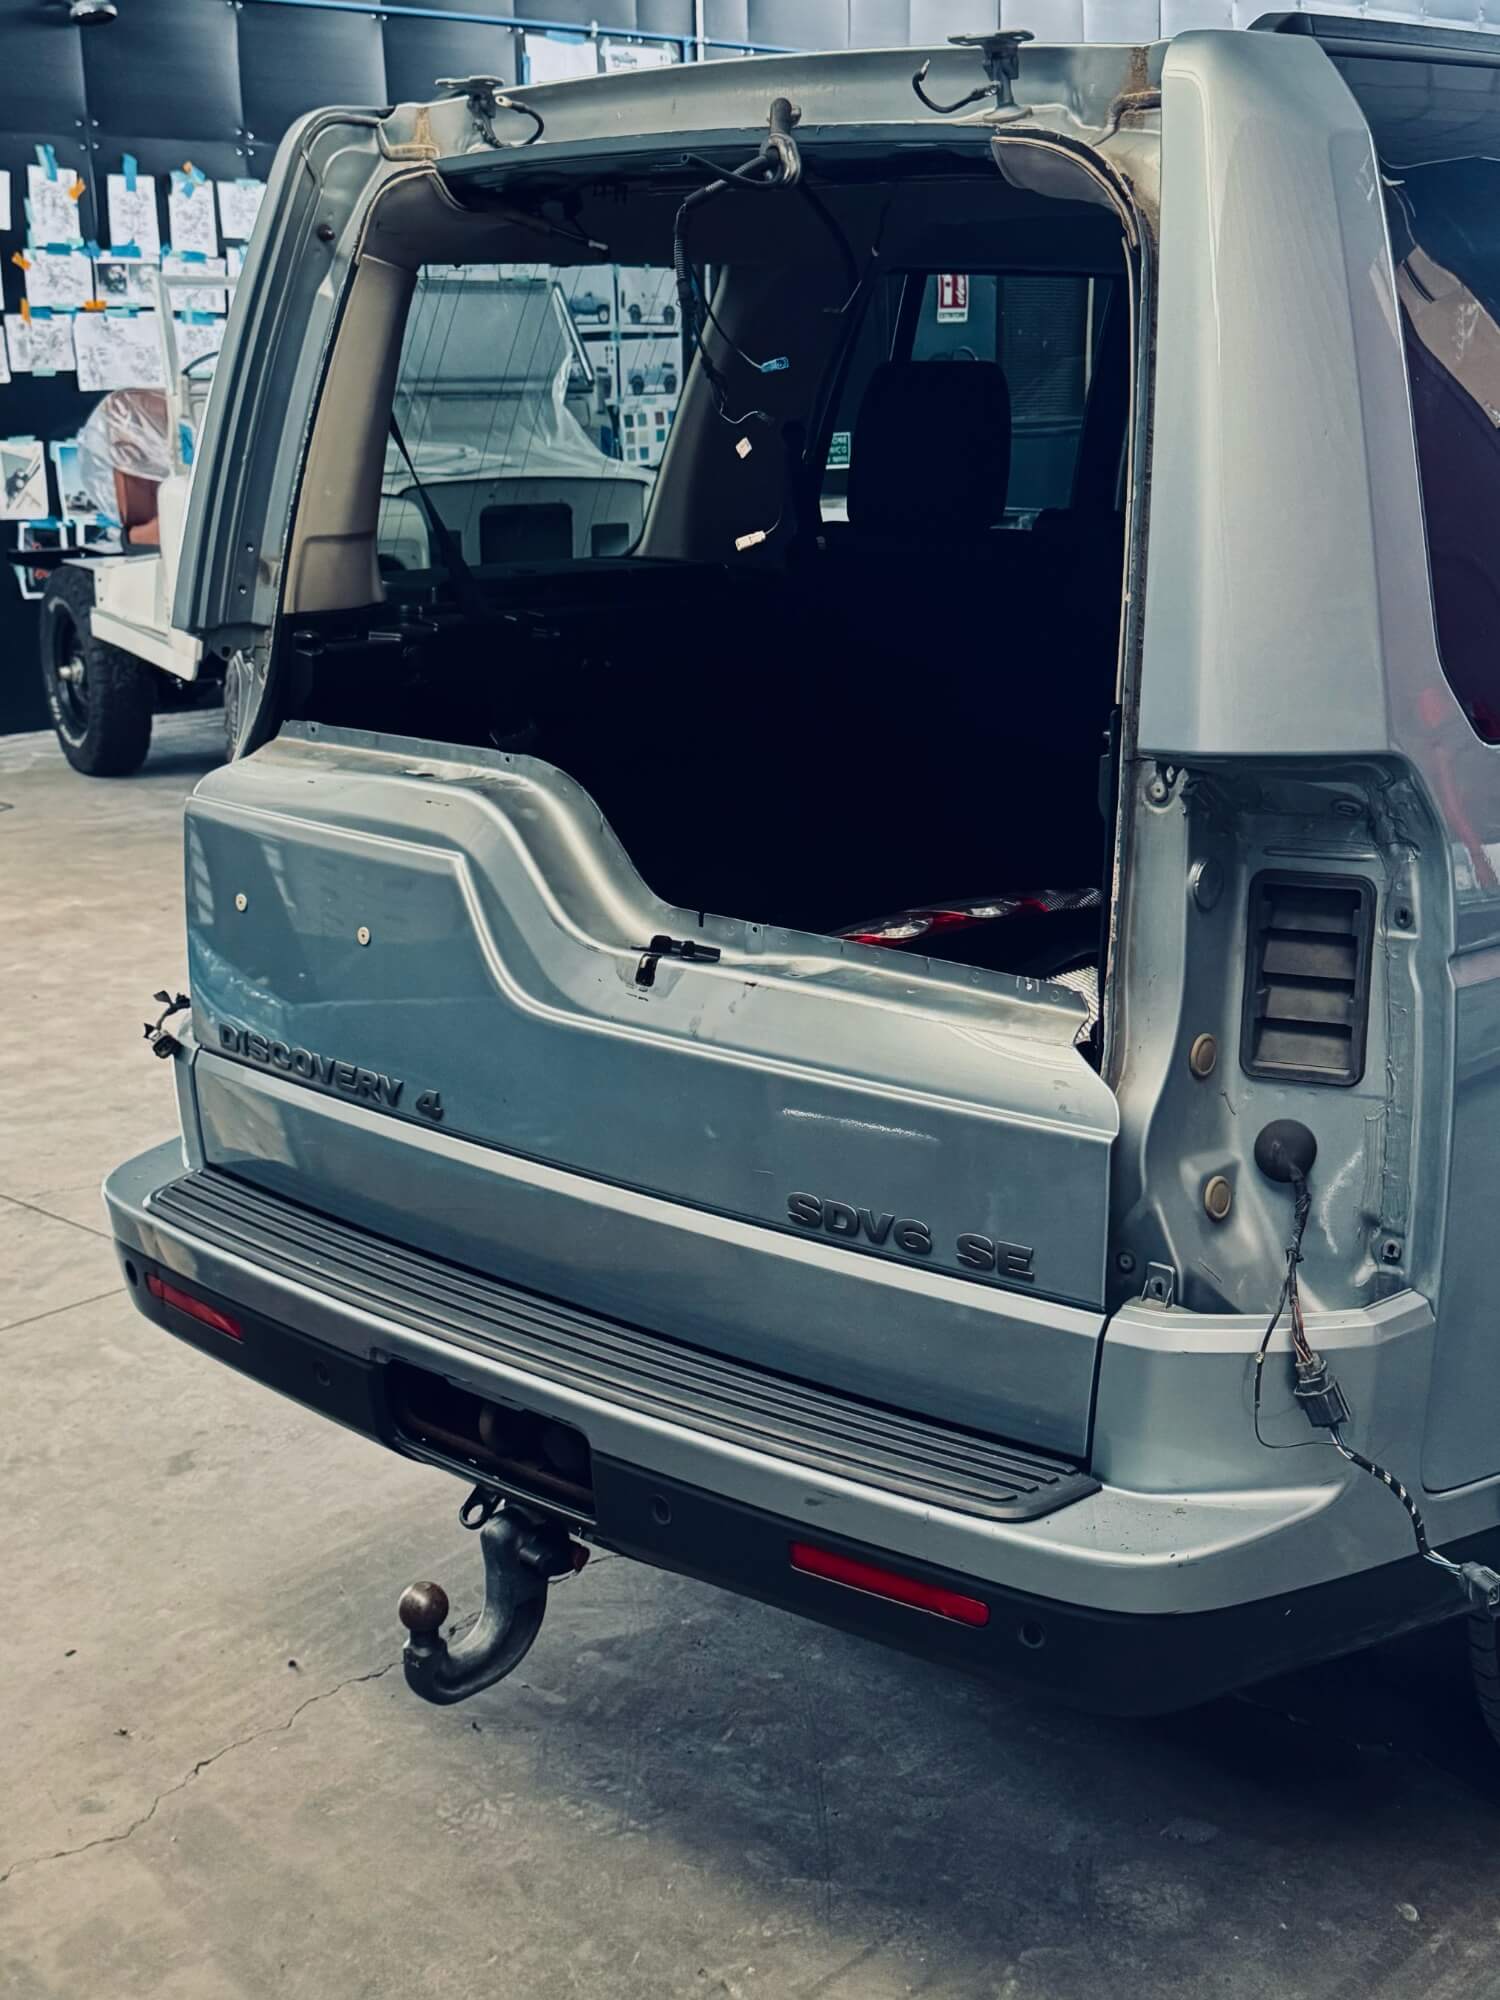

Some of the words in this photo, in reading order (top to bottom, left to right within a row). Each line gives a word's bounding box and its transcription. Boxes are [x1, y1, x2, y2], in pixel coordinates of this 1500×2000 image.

[218, 1022, 404, 1107] DISCOVERY
[415, 1089, 444, 1120] 4
[786, 1191, 932, 1255] SDV6
[955, 1232, 1035, 1282] SE
